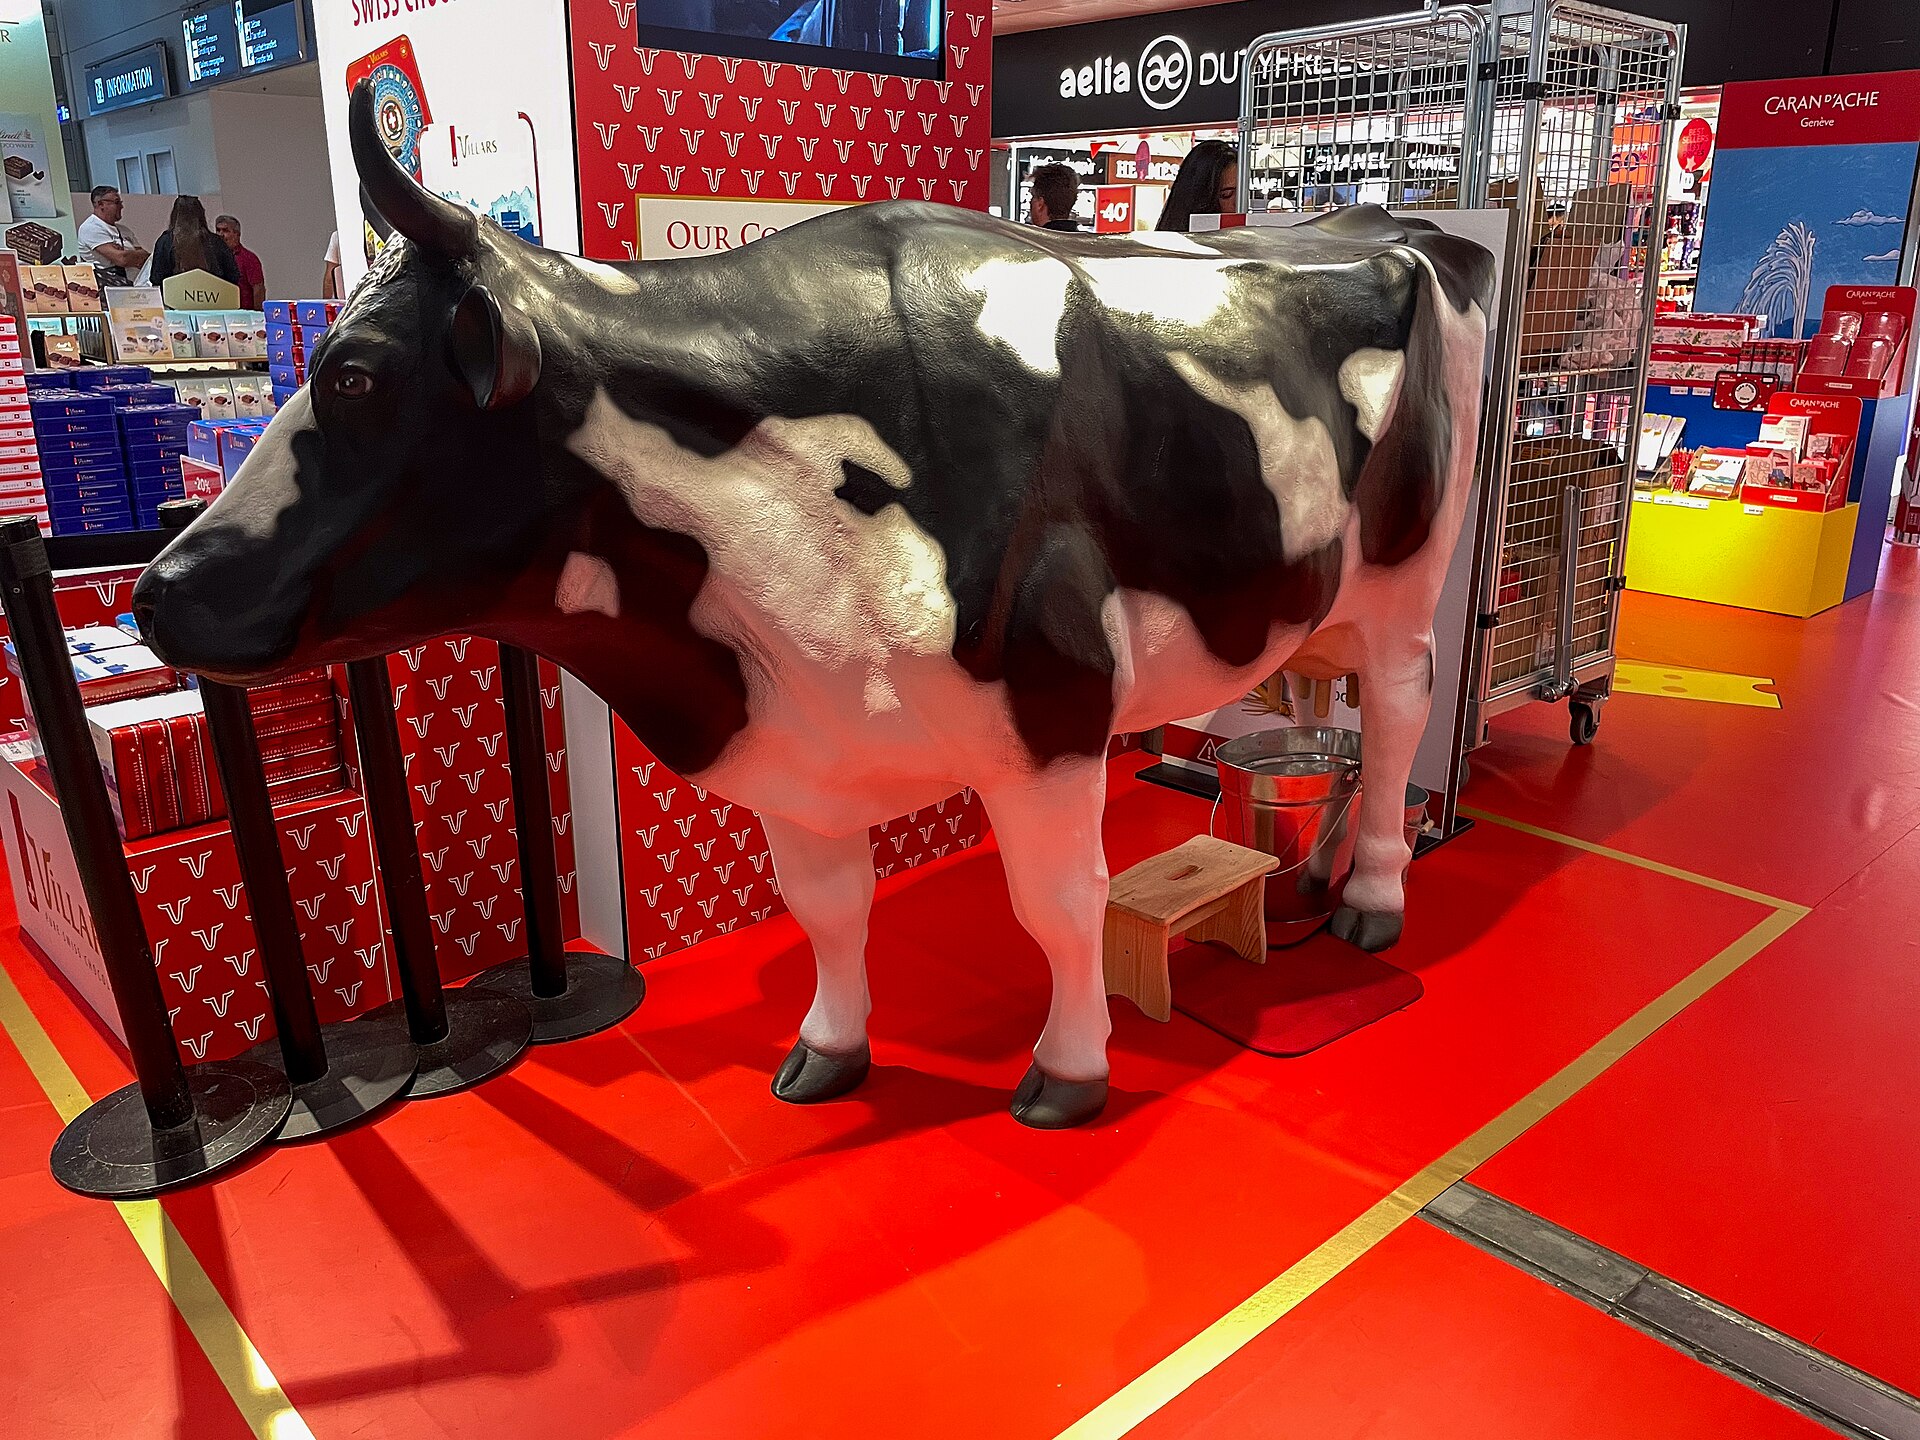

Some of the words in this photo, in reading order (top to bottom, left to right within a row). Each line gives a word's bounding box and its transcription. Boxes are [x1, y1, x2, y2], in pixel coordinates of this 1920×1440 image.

[106, 66, 153, 98] INFORMATION
[1060, 55, 1131, 99] aelia
[1764, 94, 1822, 115] CARAN
[1800, 116, 1835, 128] Genève
[1315, 150, 1392, 172] CHANEL
[1408, 151, 1457, 172] CHANEL
[666, 221, 733, 250] OUR
[184, 290, 220, 303] NEW
[194, 477, 211, 495] -20%
